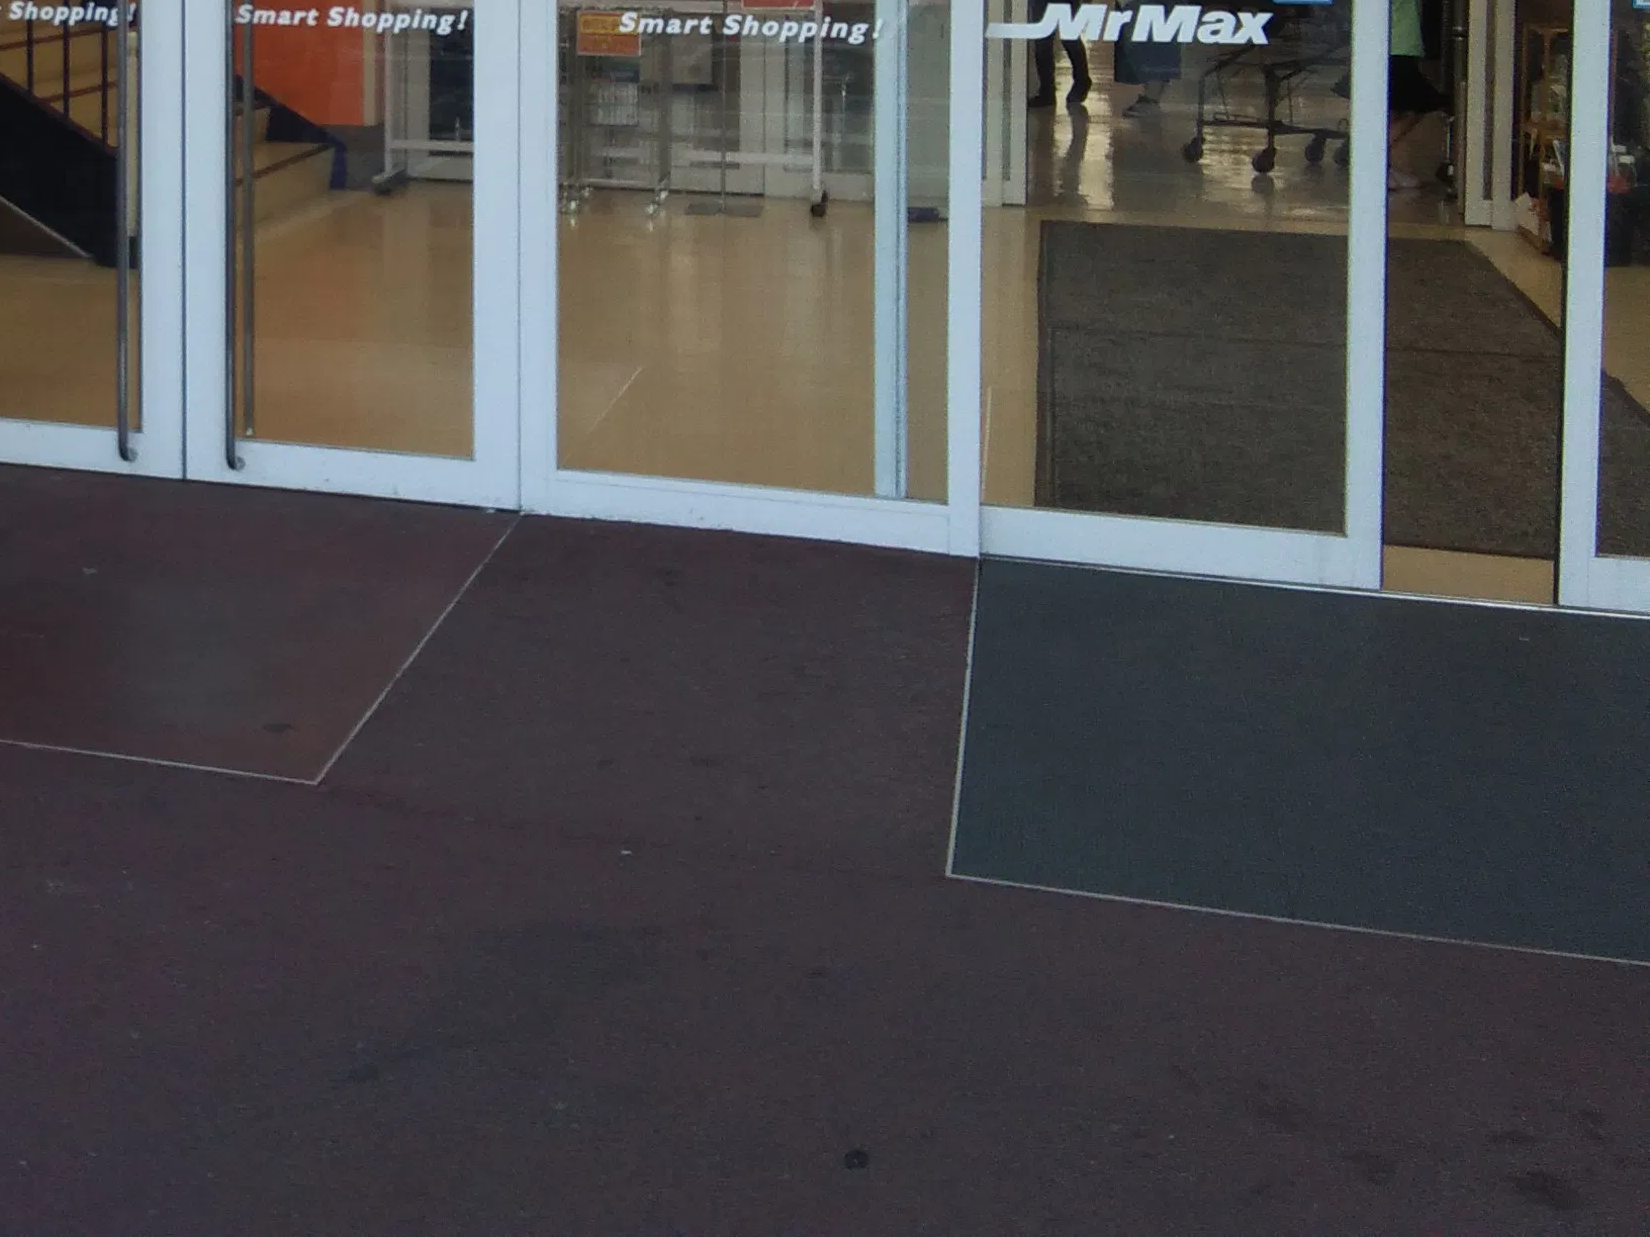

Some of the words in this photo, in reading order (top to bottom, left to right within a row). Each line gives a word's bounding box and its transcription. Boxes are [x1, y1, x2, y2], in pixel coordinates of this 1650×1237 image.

[235, 3, 320, 27] Smart
[326, 5, 469, 36] Shopping!
[618, 11, 714, 35] Smart
[722, 13, 885, 45] Shopping!
[985, 2, 1274, 45] MrMax
